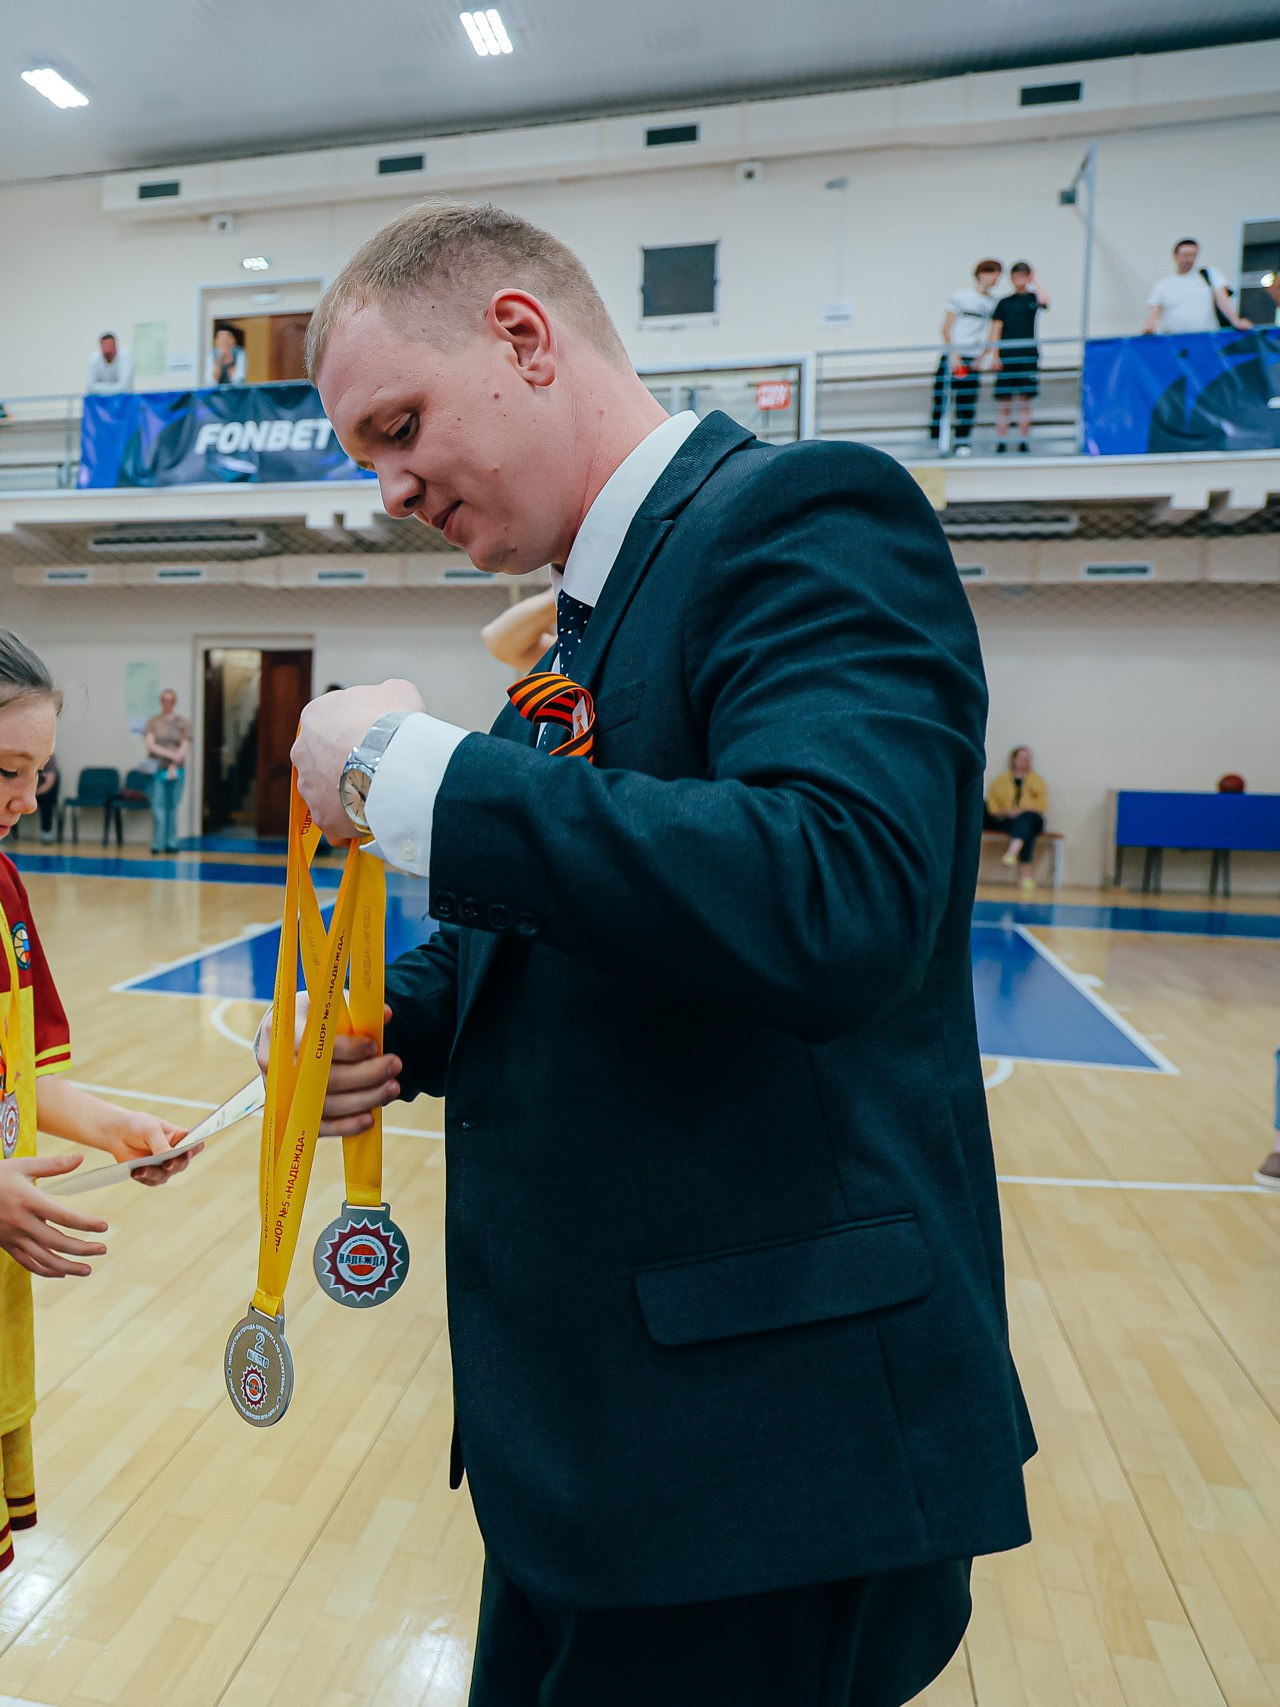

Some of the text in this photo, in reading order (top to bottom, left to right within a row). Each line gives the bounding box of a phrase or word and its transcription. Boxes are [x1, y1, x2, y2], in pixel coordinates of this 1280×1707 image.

[194, 418, 333, 455] FONBET
[315, 1023, 326, 1059] СШОР
[279, 1201, 290, 1218] №5
[285, 1130, 306, 1199] «НАДЕЖДА»
[338, 1252, 385, 1267] НАДЕЖДА
[254, 1331, 266, 1354] 2
